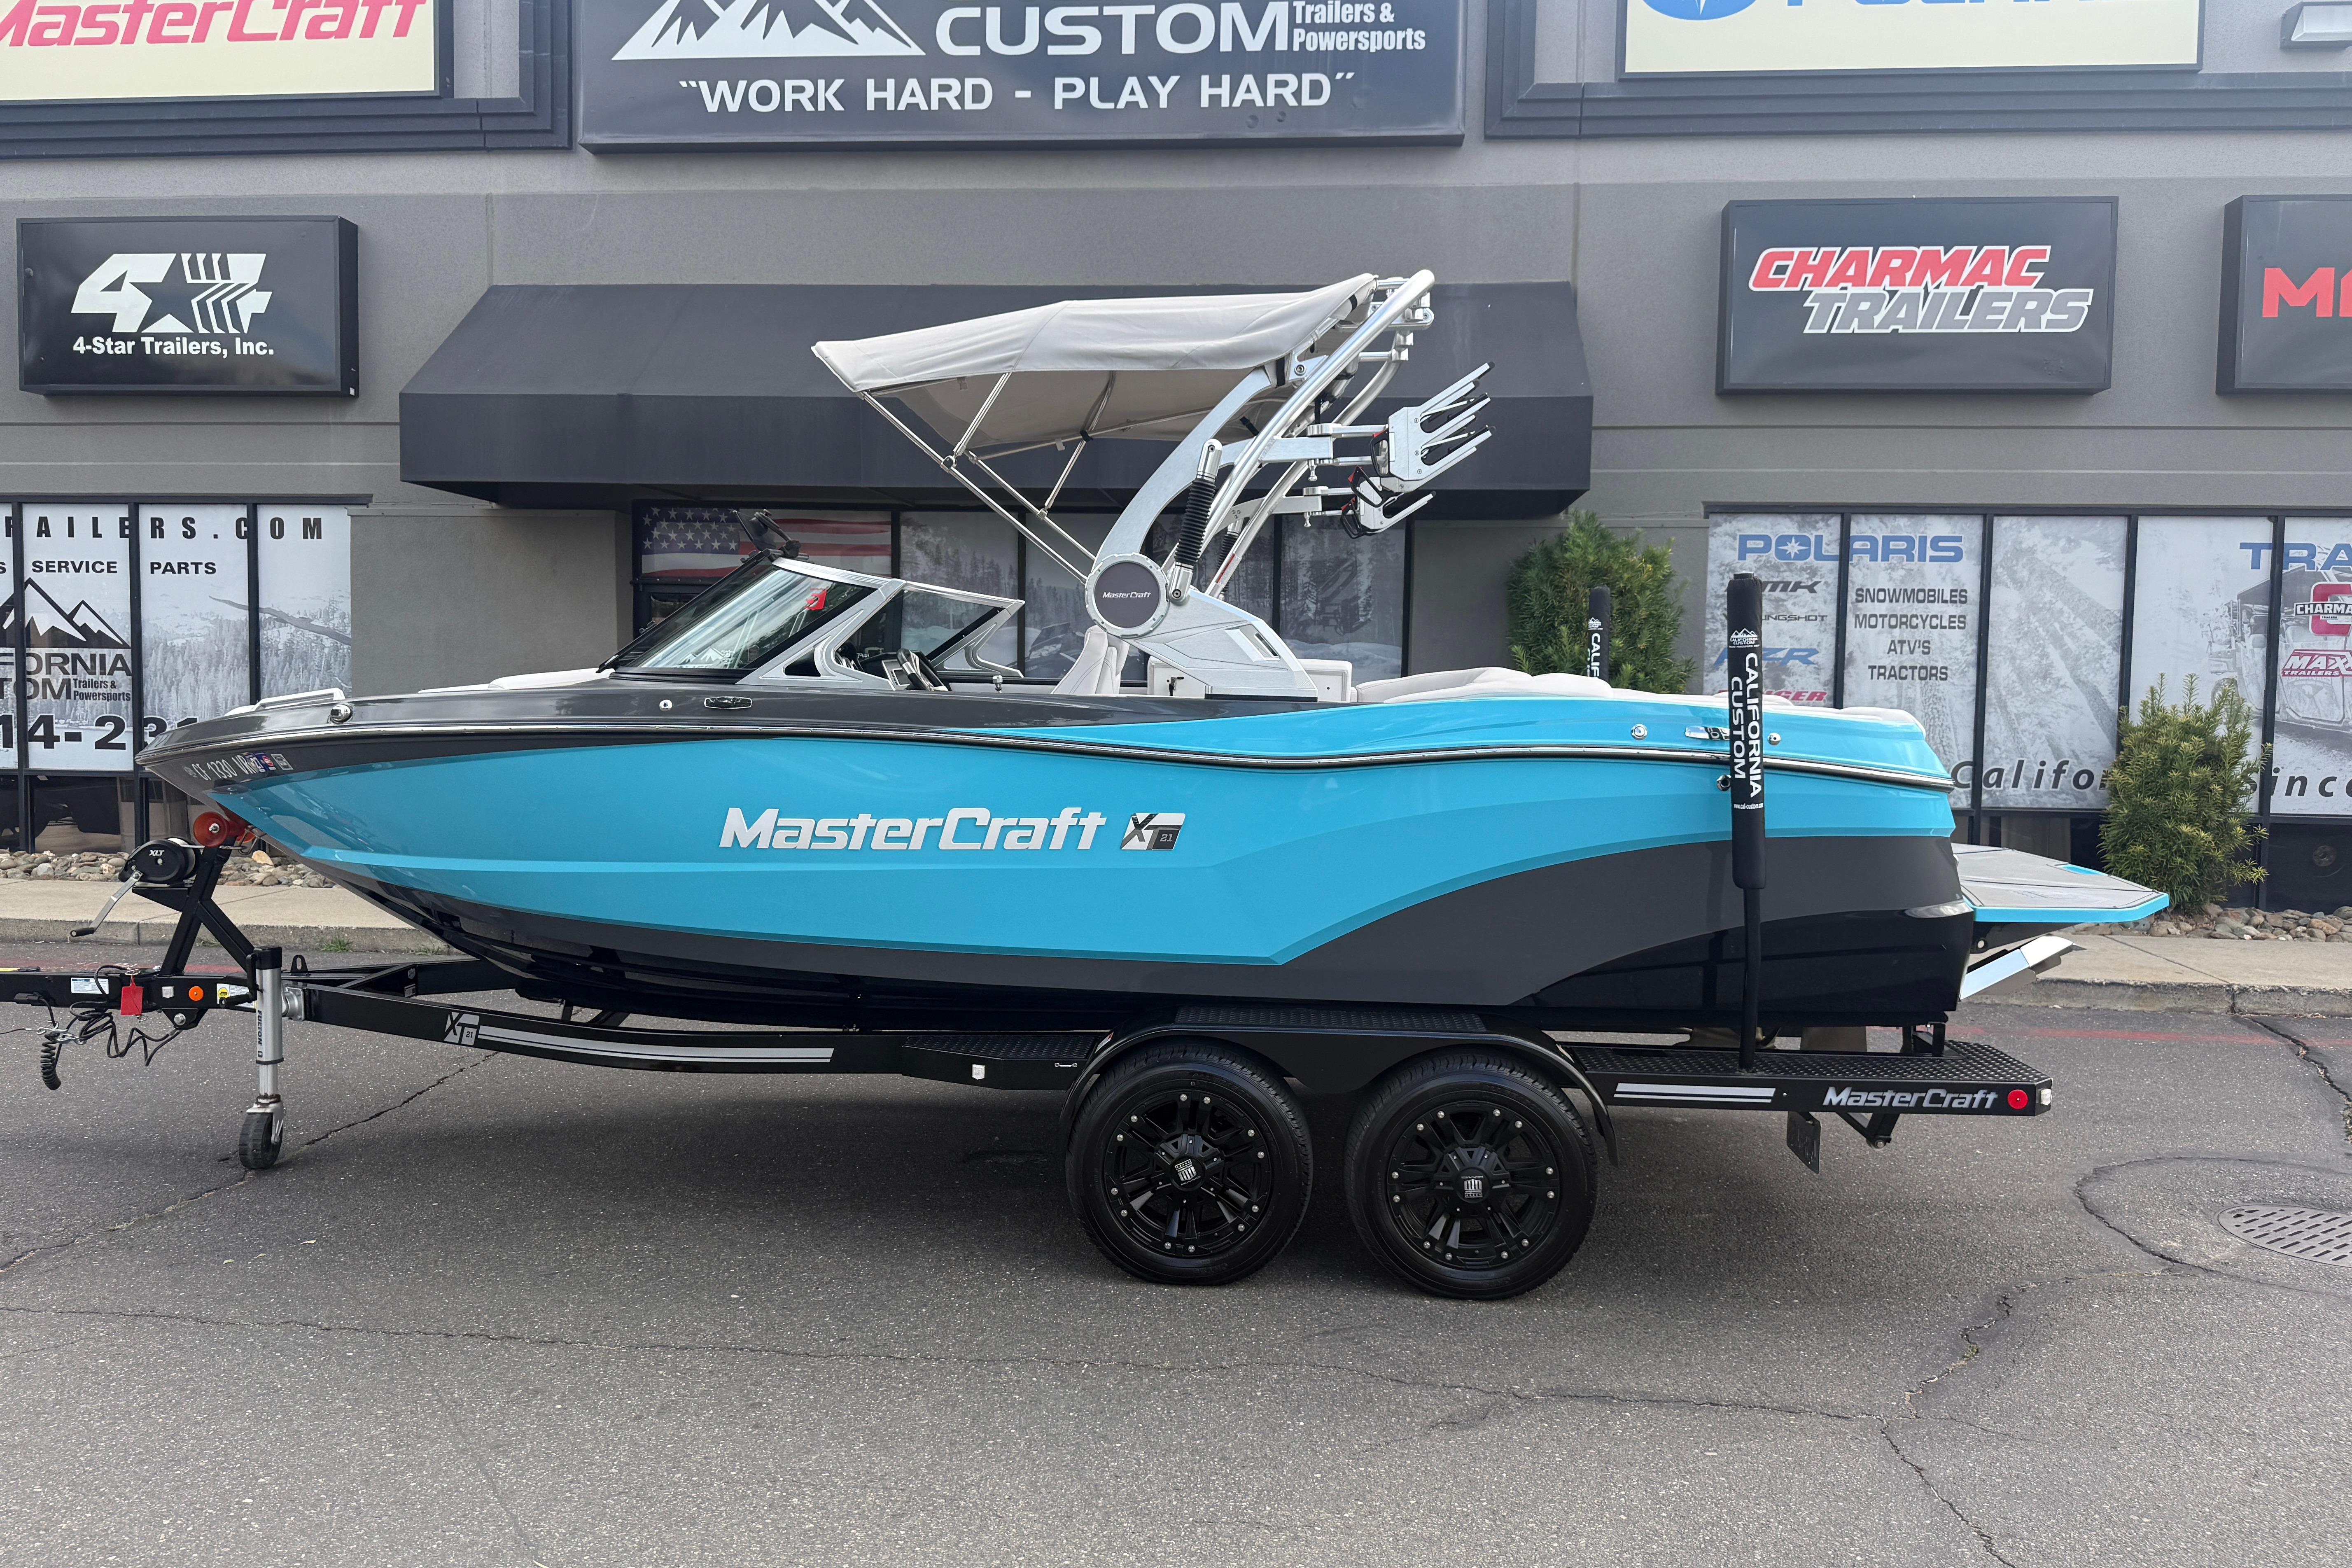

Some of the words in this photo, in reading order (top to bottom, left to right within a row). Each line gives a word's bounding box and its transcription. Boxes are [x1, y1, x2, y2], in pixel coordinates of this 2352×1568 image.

[1293, 0, 1376, 24] Trailers
[1379, 3, 1395, 23] &
[936, 1, 1288, 56] CUSTOM
[1293, 28, 1426, 52] Powersports
[867, 78, 994, 111] HARD
[1054, 75, 1180, 110] PLAY
[1749, 245, 2051, 291] CHARMAC
[1803, 288, 2094, 334] TRAILERS
[73, 336, 135, 355] 4-Star
[141, 337, 228, 359] Trailers,
[236, 337, 274, 355] Inc.
[1738, 534, 1963, 562] POLARIS
[32, 560, 118, 574] SERVICE
[150, 562, 217, 575] PARTS
[1855, 588, 1968, 605] SNOWMOBILES
[1854, 614, 1966, 630] MOTORCYCLES
[1887, 639, 1931, 655] ATV'S
[73, 678, 108, 689] Trailers
[110, 680, 117, 689] &
[1868, 665, 1948, 681] TRACTORS
[73, 691, 131, 702] Powersports
[1731, 677, 1746, 779] CUSTOM
[1745, 653, 1762, 798] CALIFORNIA
[192, 763, 211, 780] CF
[207, 759, 237, 779] 1330
[719, 807, 1107, 851] MasterCraft
[1160, 833, 1173, 842] 21
[1822, 1085, 1998, 1109] MasterCraft
